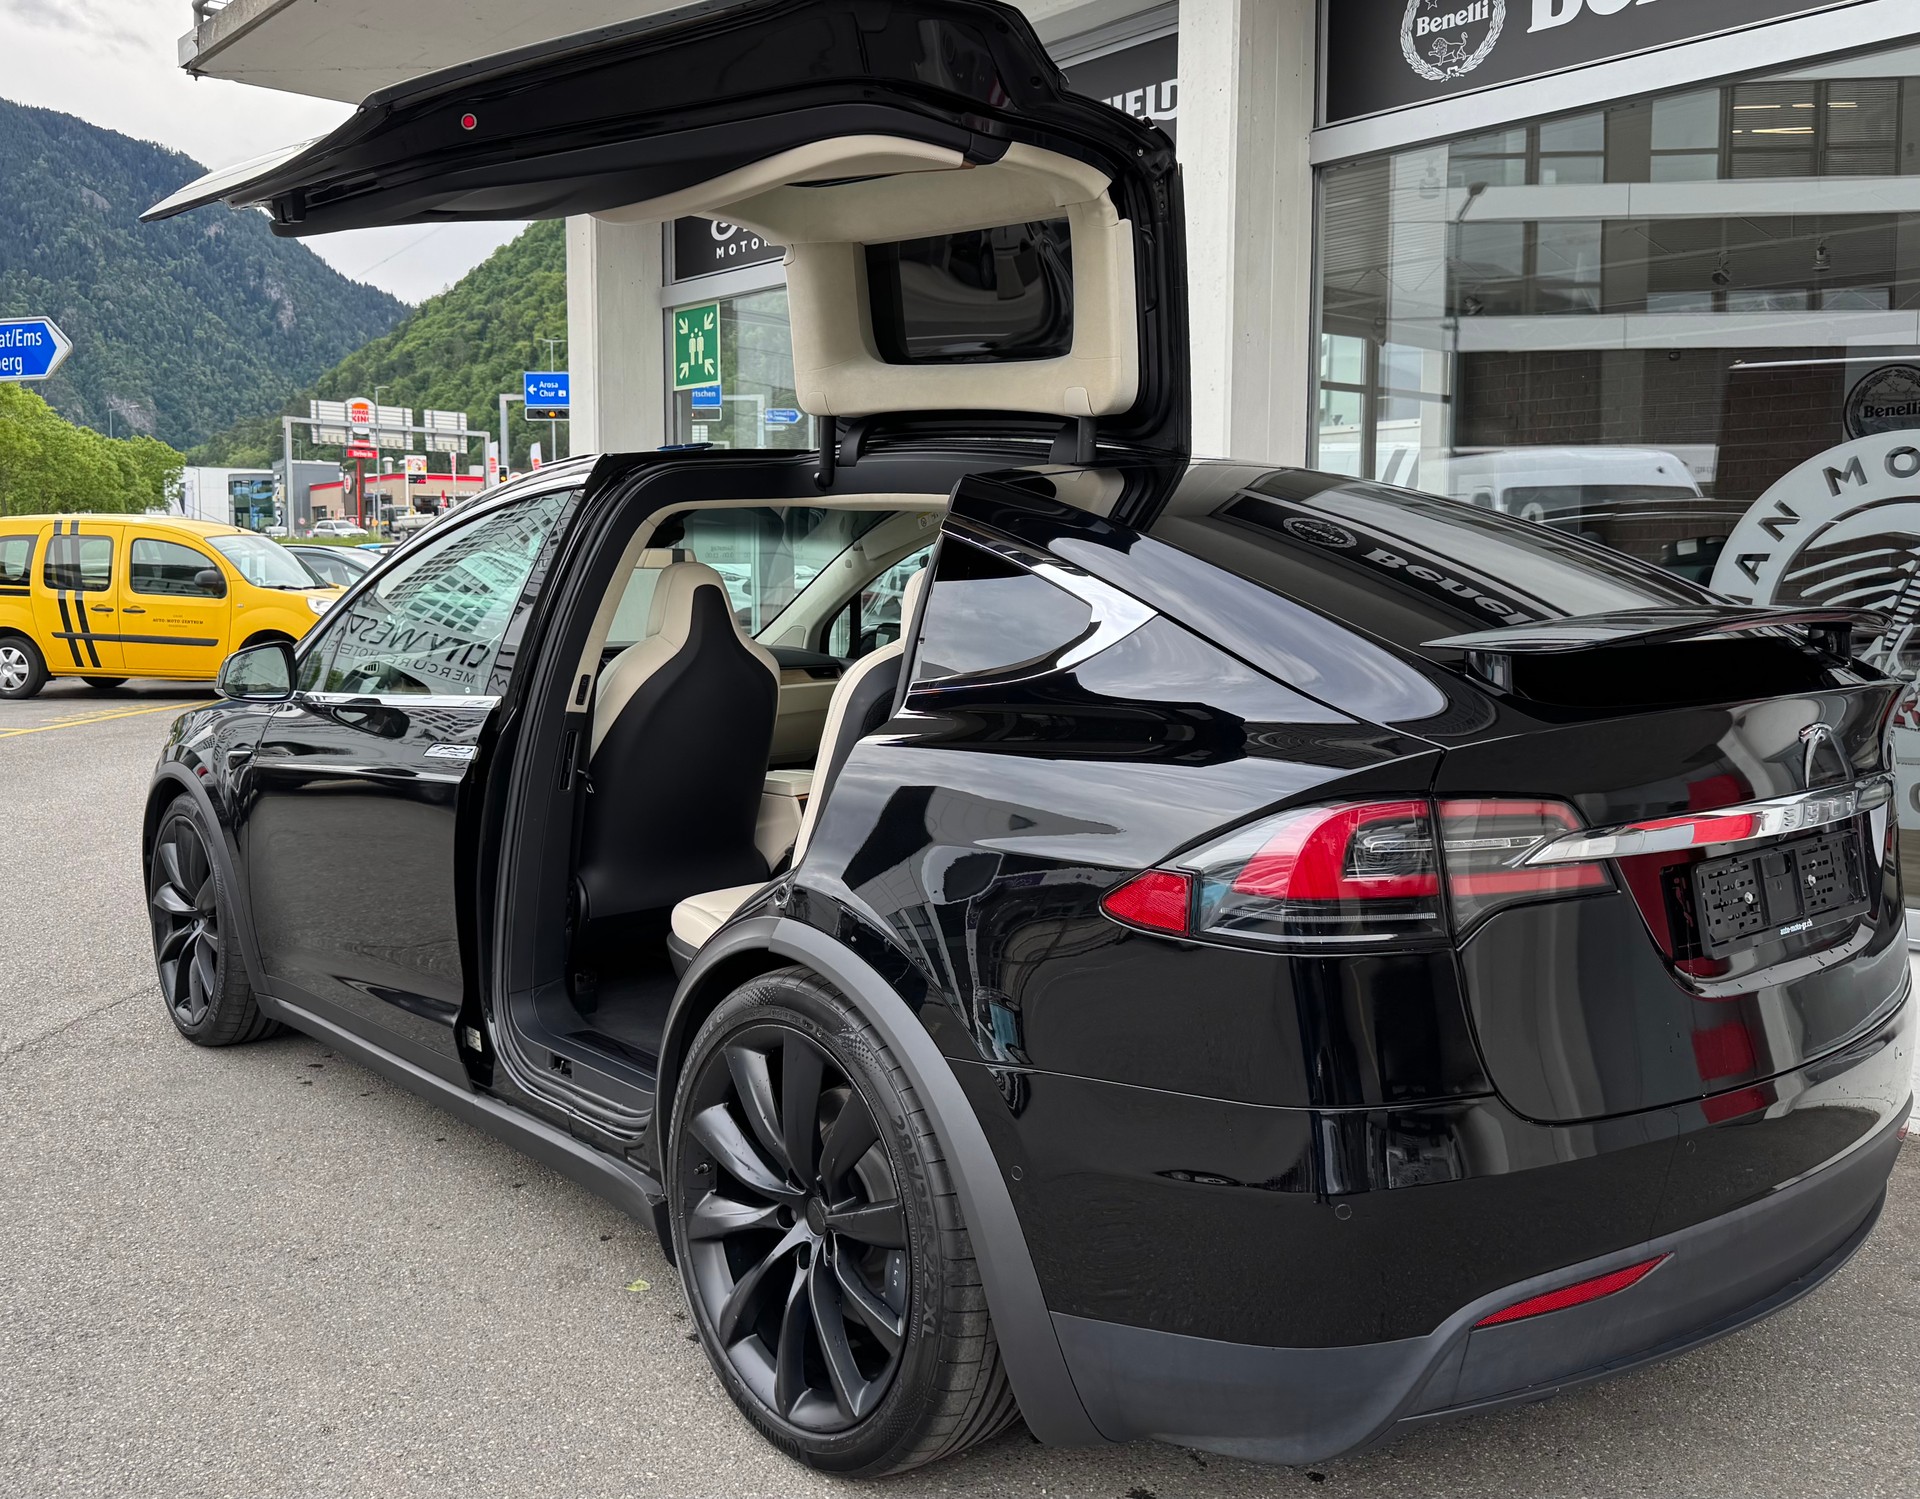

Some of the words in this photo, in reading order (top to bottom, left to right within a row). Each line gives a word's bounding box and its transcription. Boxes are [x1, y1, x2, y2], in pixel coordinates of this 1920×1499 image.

[1416, 0, 1490, 37] Benelli
[1101, 79, 1178, 120] IELD
[0, 356, 23, 375] erg
[539, 389, 556, 397] Chur
[1863, 401, 1920, 419] Benelli
